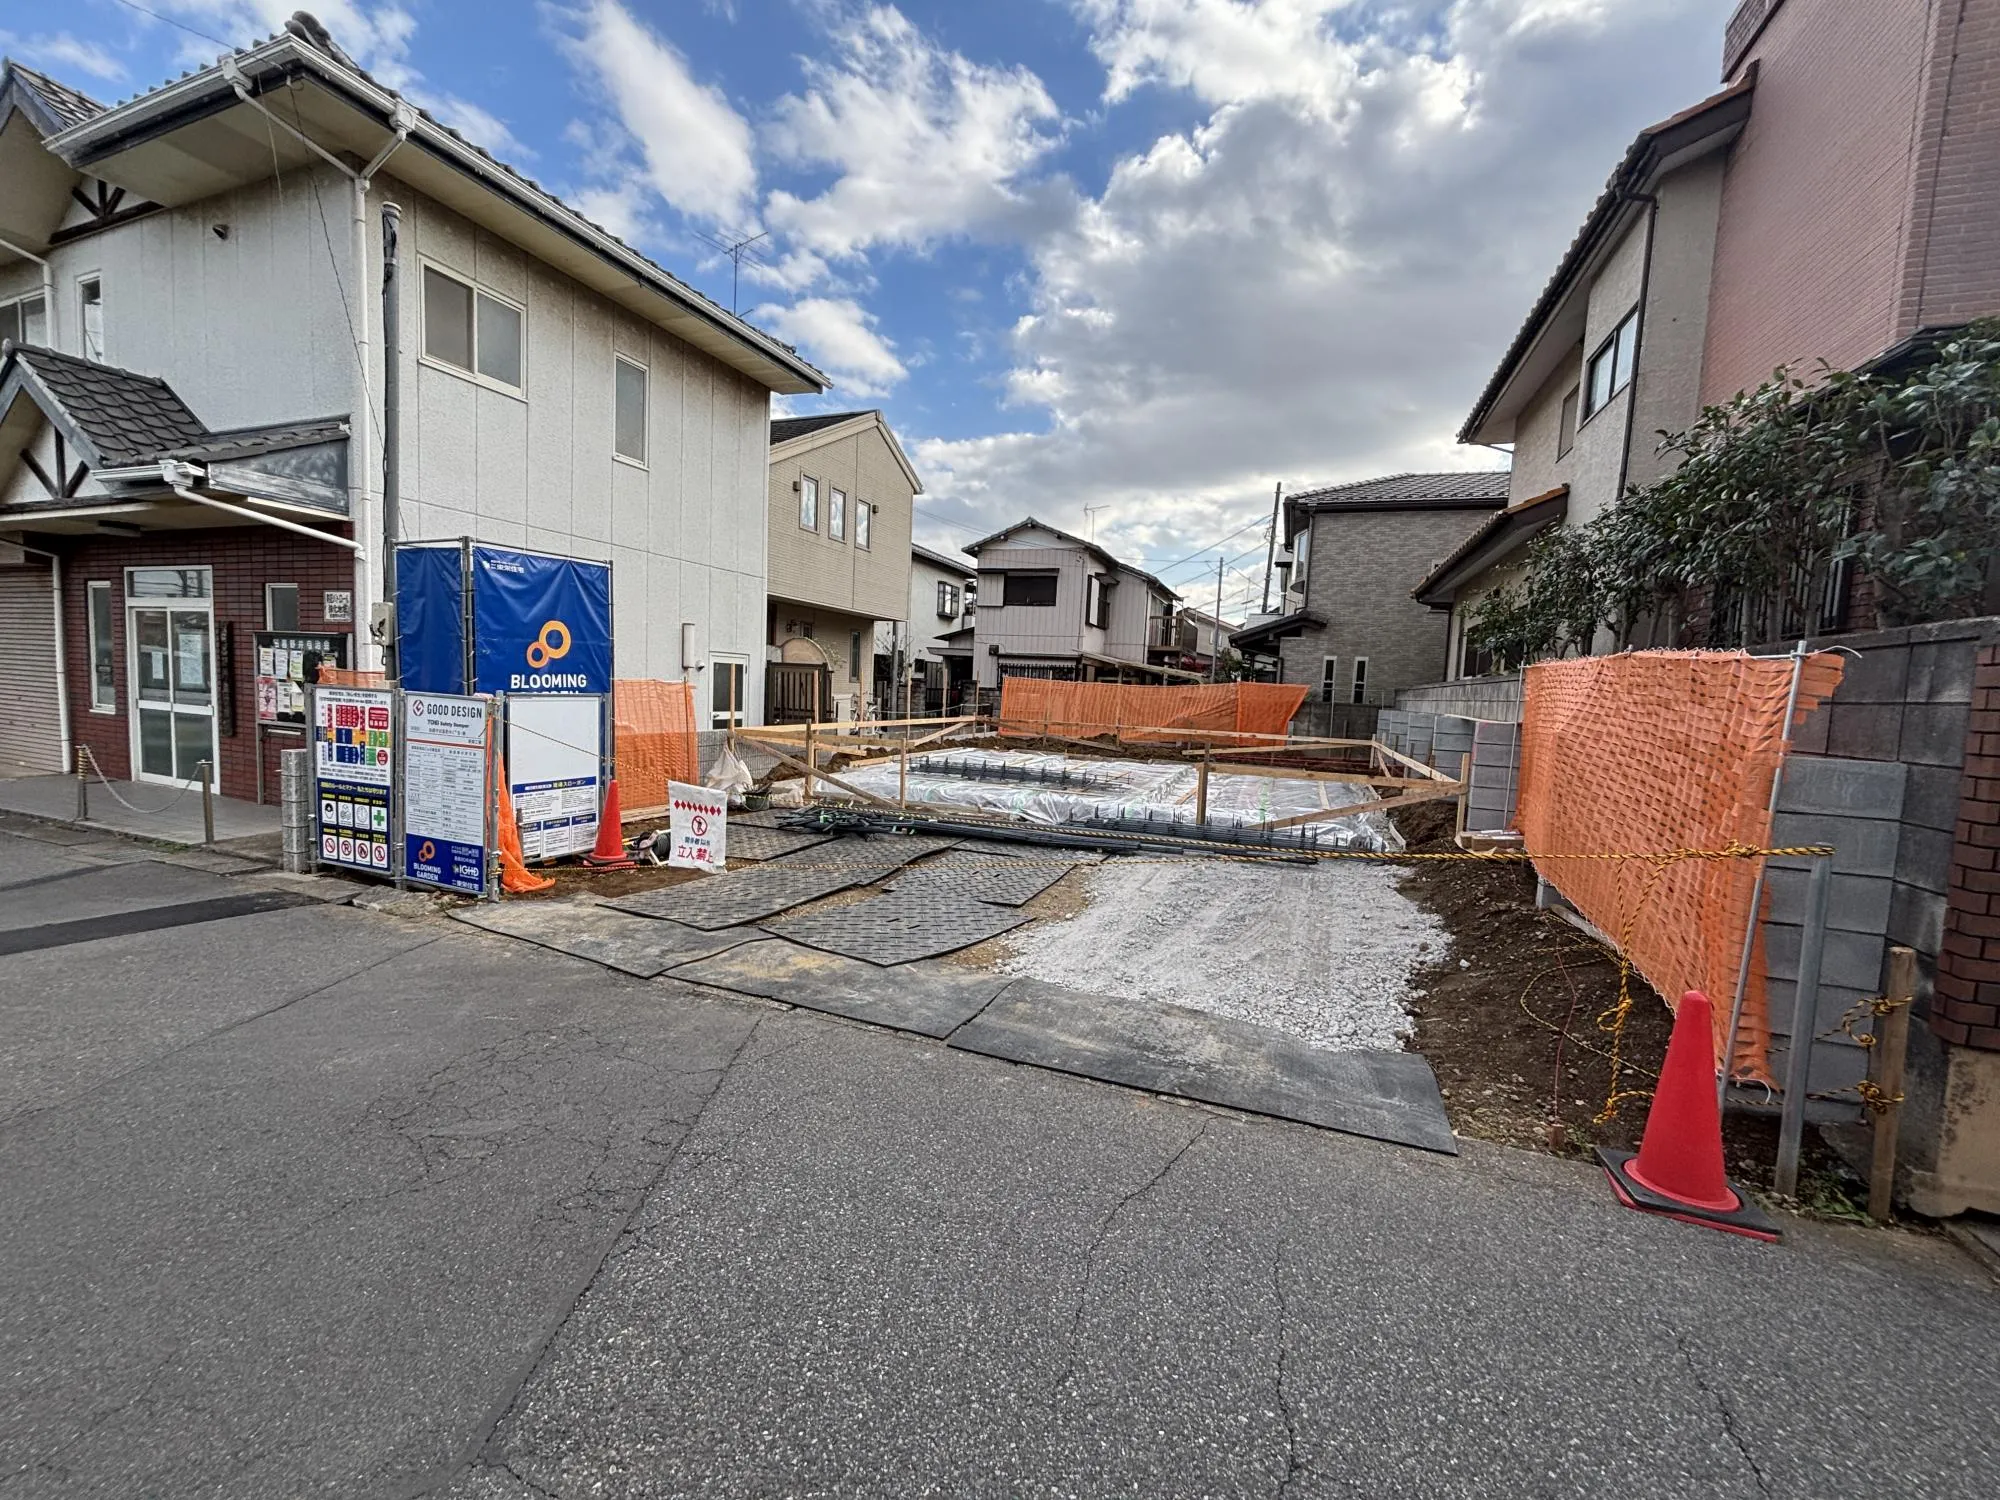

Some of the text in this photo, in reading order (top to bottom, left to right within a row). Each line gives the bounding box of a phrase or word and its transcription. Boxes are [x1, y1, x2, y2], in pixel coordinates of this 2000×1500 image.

[510, 674, 587, 689] BLOOMING
[427, 703, 483, 719] GOOD DESIGN
[677, 845, 714, 864] 立入禁止
[413, 862, 442, 875] BLOOMING
[416, 870, 439, 882] GARDEN
